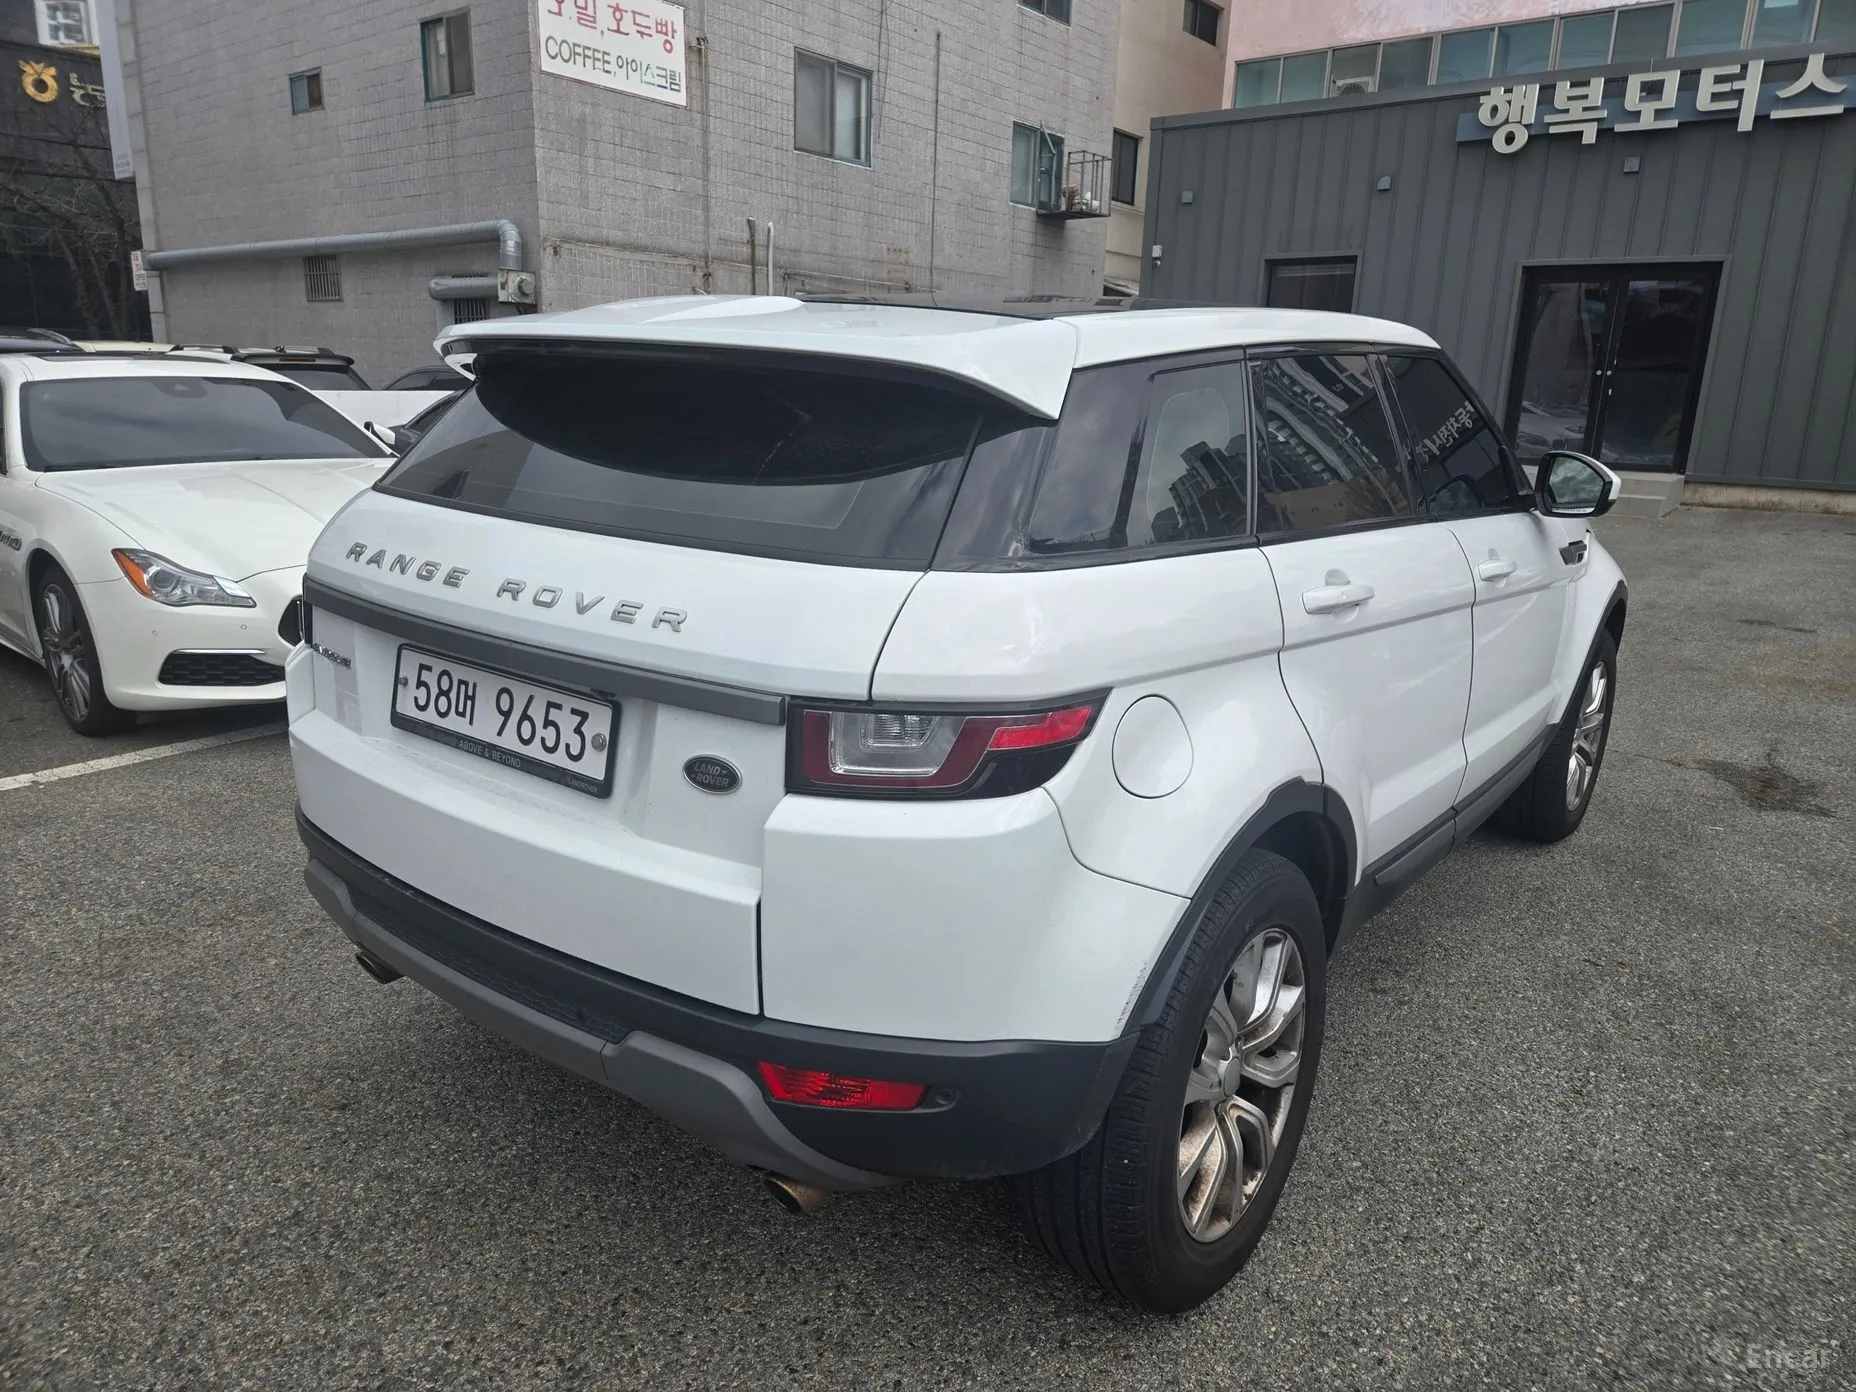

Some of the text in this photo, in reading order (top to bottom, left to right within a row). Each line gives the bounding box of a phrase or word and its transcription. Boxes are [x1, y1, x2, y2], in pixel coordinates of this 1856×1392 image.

[1478, 53, 1847, 154] 행복모터스
[345, 541, 688, 633] RANGE ROVER
[413, 663, 590, 763] 58머 9653
[458, 739, 483, 755] ABOVE
[492, 750, 521, 769] BEYOND
